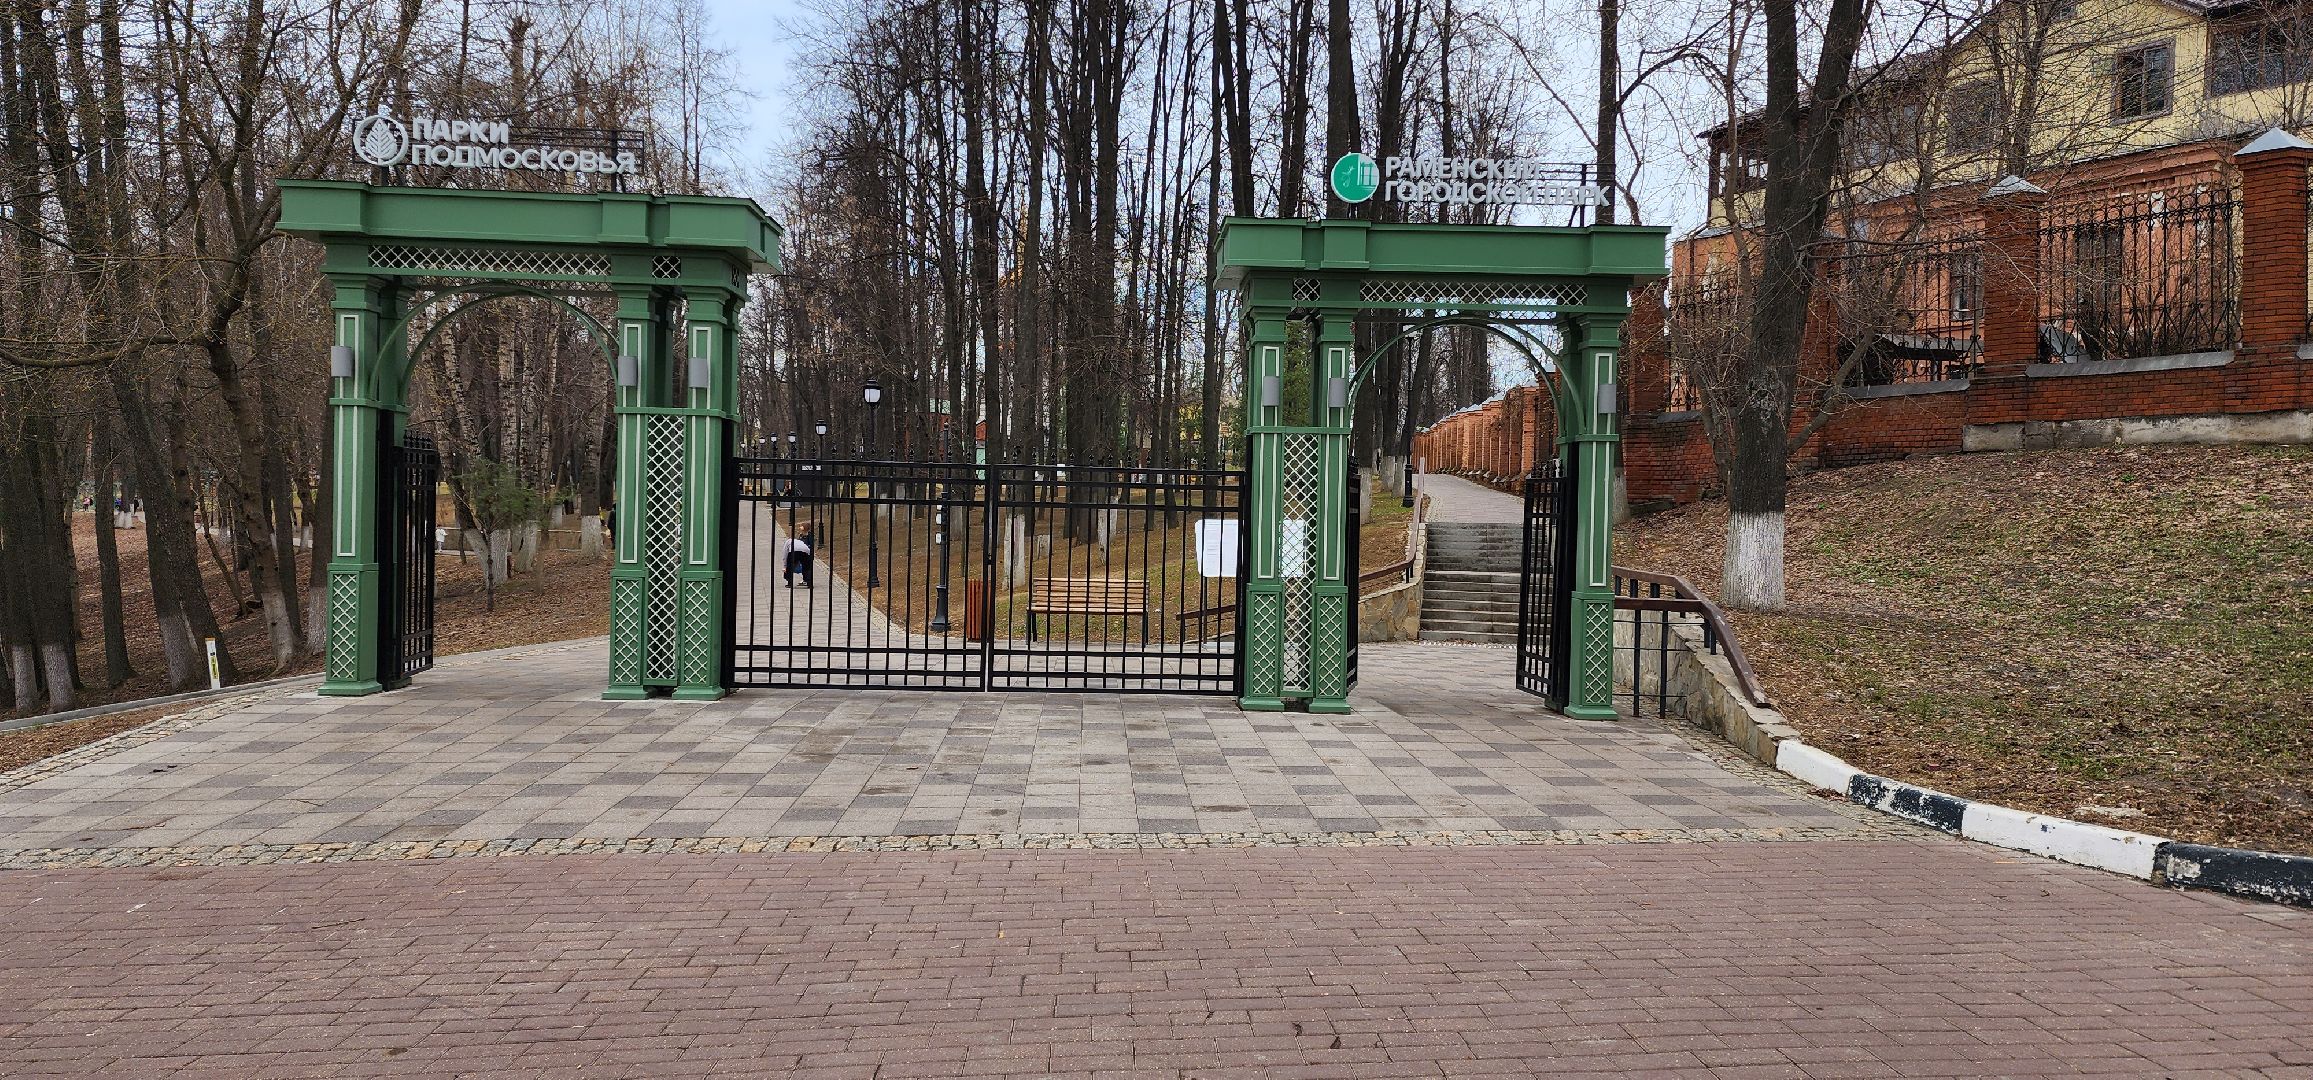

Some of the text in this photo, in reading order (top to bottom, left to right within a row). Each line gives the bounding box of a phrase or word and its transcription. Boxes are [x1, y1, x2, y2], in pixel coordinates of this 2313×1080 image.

[411, 117, 509, 143] ПАРКИ
[411, 144, 635, 173] ПОДМОСКОВЬЯ
[1385, 157, 1541, 180] РАМЕНСКИЙ
[1384, 180, 1611, 207] ГОРОДСКОЙ ПАРК
